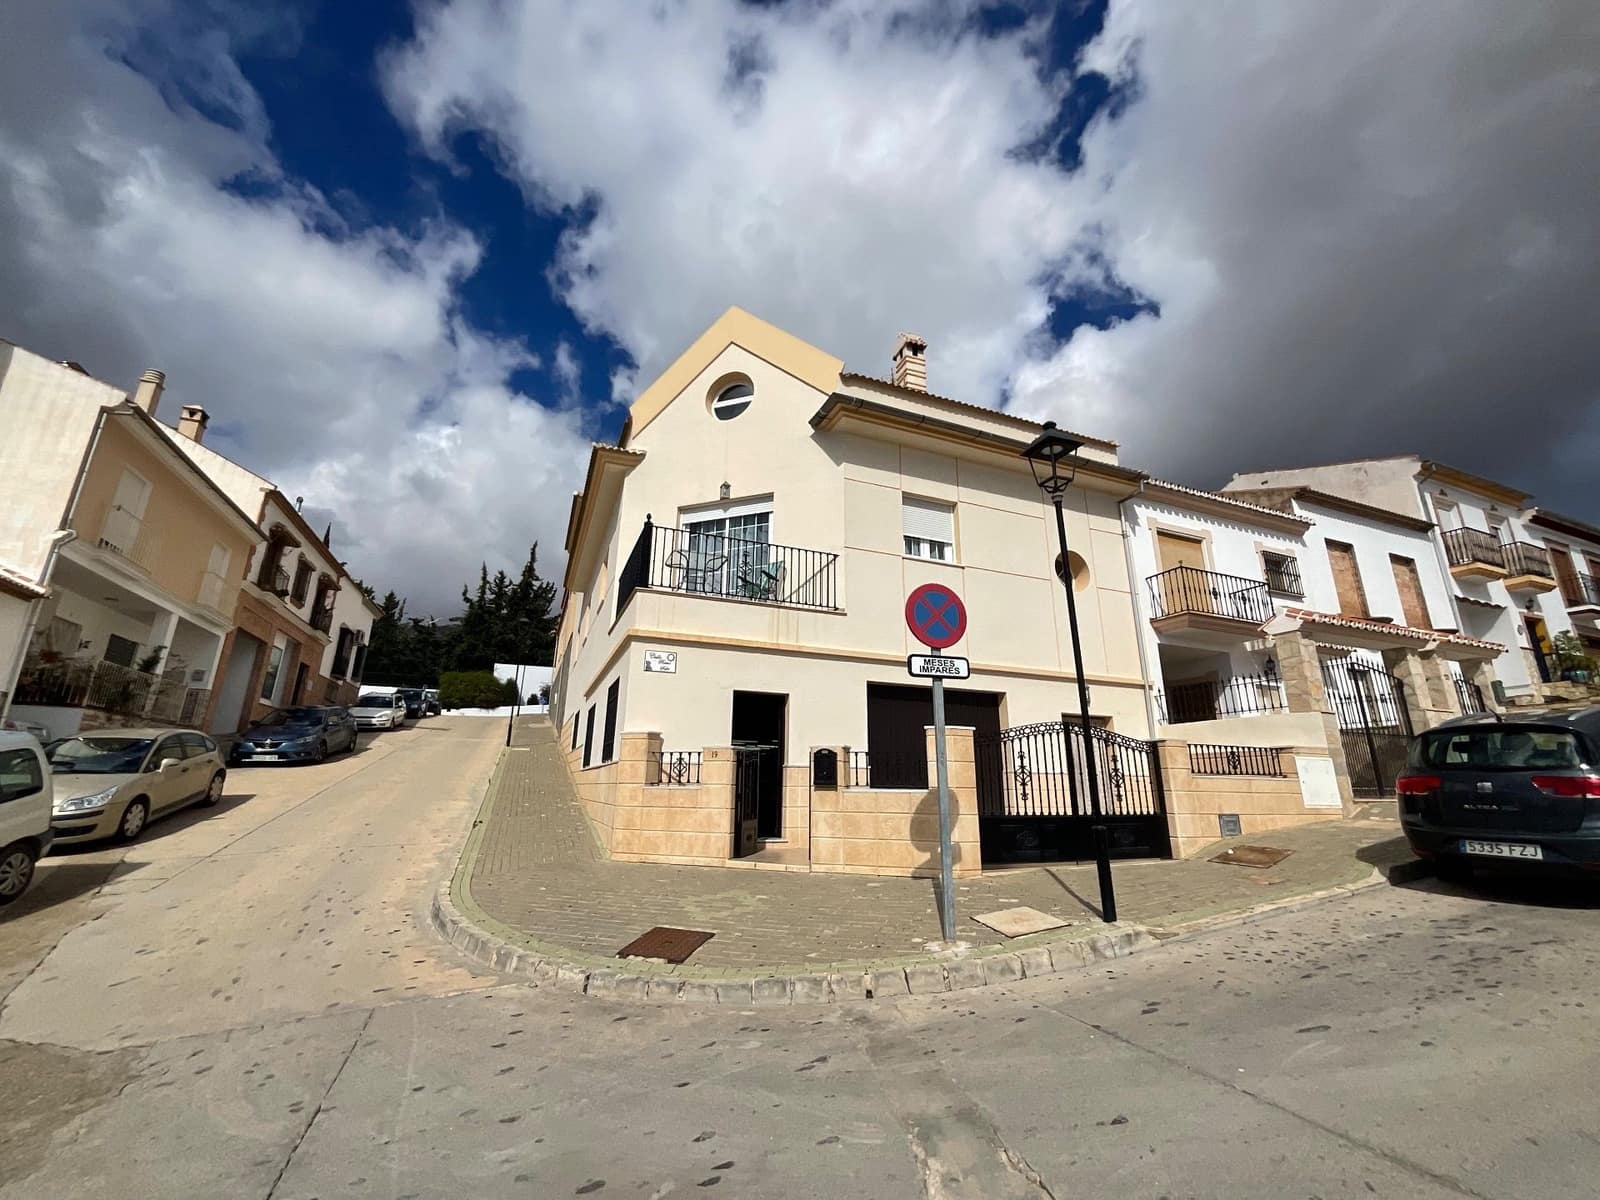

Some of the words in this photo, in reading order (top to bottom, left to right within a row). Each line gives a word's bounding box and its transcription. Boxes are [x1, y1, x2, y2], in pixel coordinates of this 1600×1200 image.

[923, 658, 956, 667] MESES
[919, 665, 961, 675] IMPARES
[1468, 841, 1504, 855] 5335
[1508, 844, 1538, 857] FZJ
